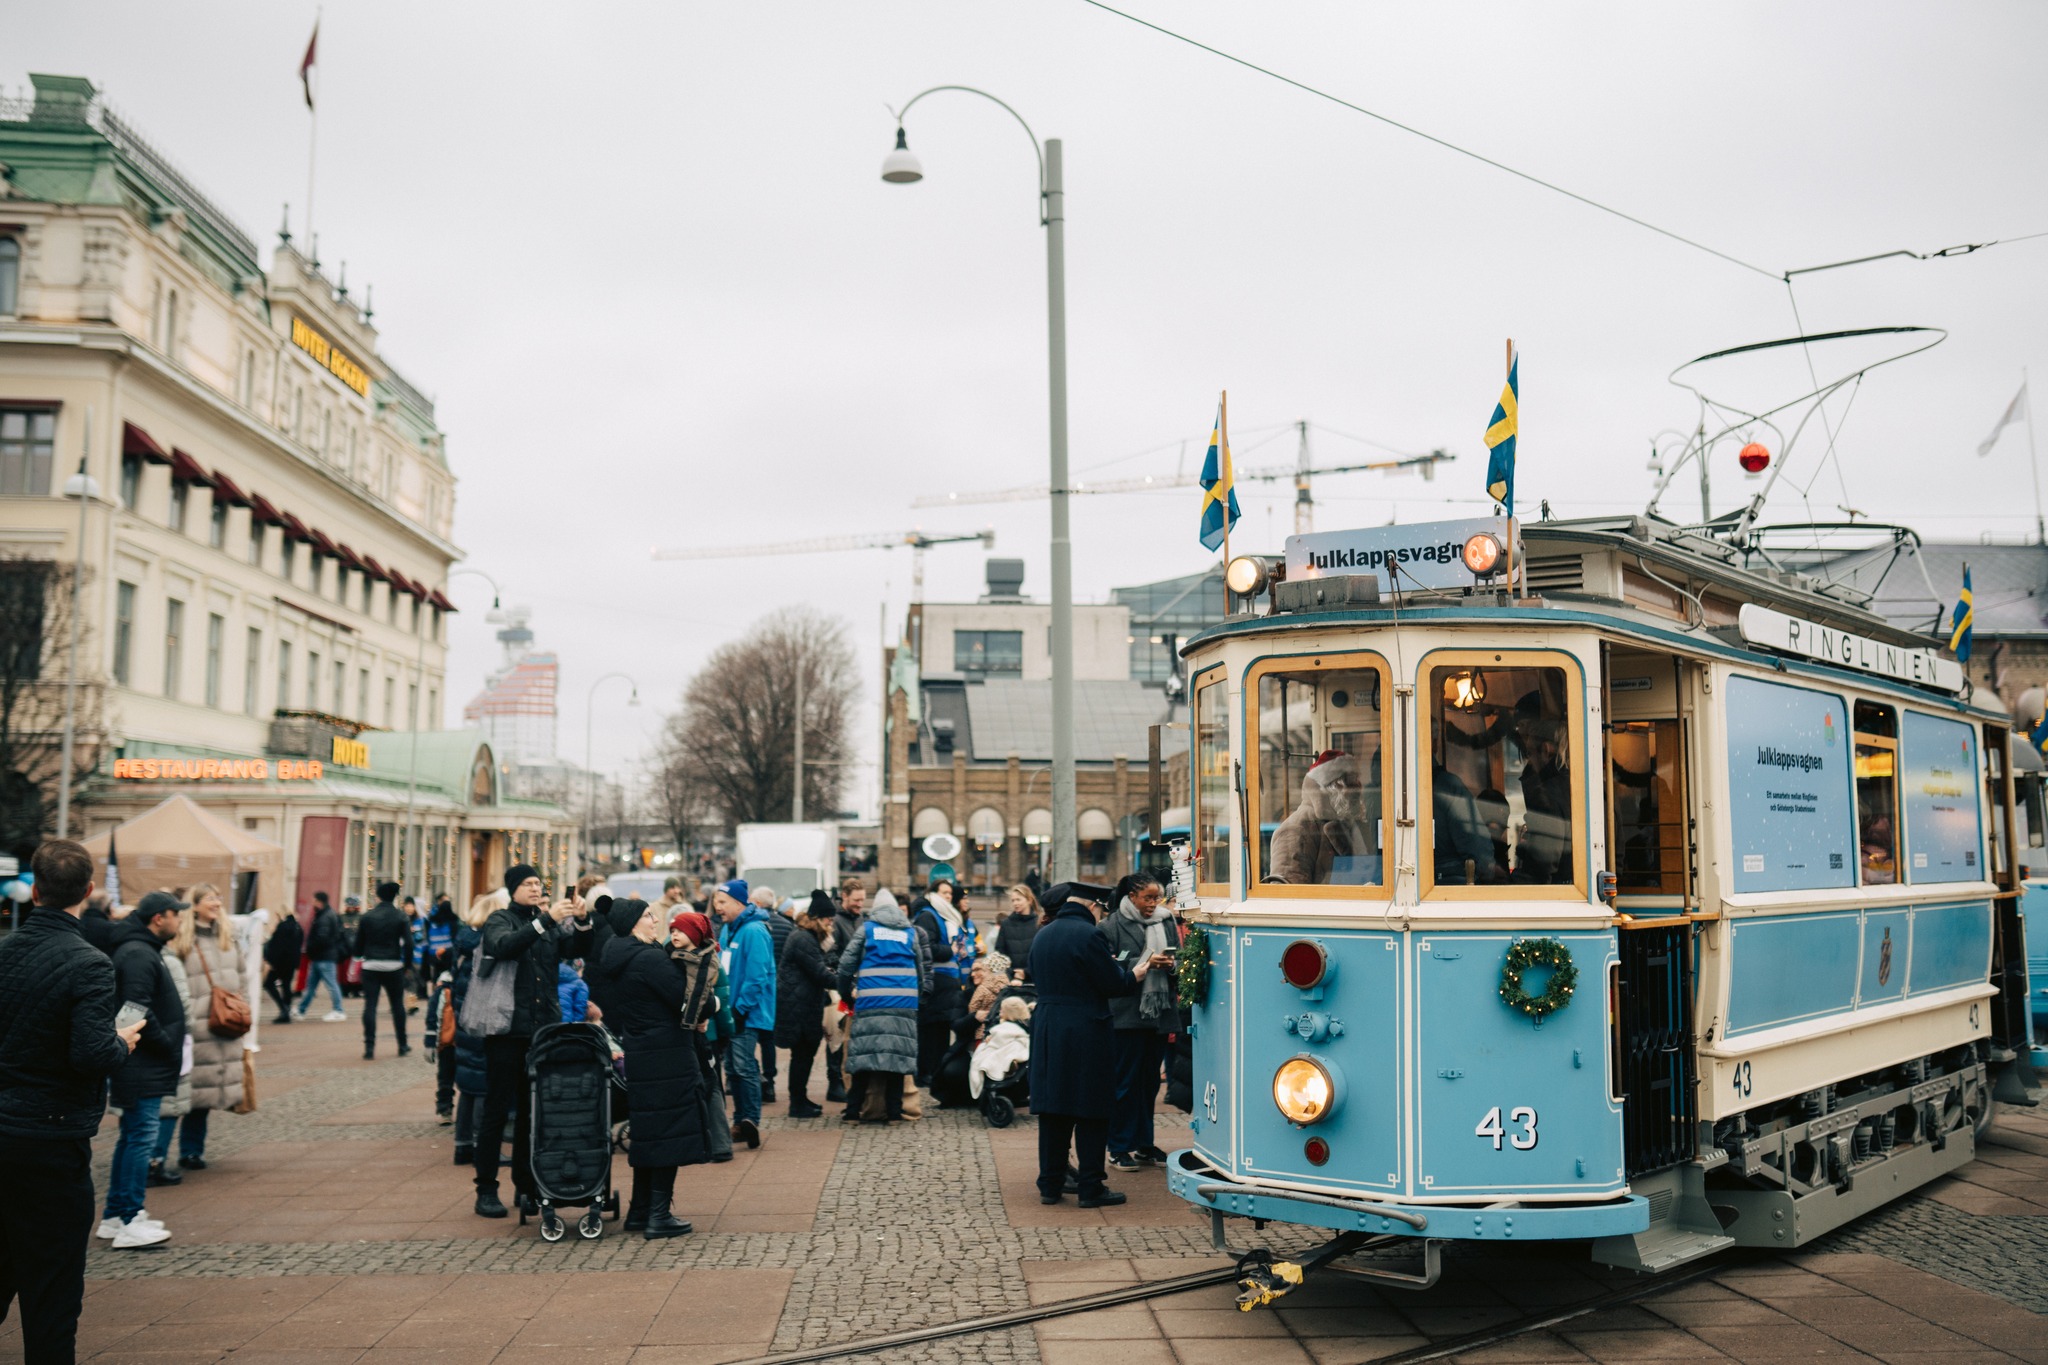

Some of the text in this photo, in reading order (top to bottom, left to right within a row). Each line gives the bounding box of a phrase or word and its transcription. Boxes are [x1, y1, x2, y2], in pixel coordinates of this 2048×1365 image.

[292, 317, 330, 369] HOTEL
[1306, 541, 1463, 570] Julklappsvagn
[1788, 619, 1937, 683] RINGLINIEN
[113, 759, 323, 780] RESTAURANG BAR
[332, 735, 370, 769] HOTEL
[1757, 746, 1823, 773] Julklappsvagnen
[1969, 1003, 1979, 1029] 43
[1733, 1060, 1751, 1099] 43
[1203, 1080, 1218, 1124] 43
[1475, 1106, 1538, 1151] 43
